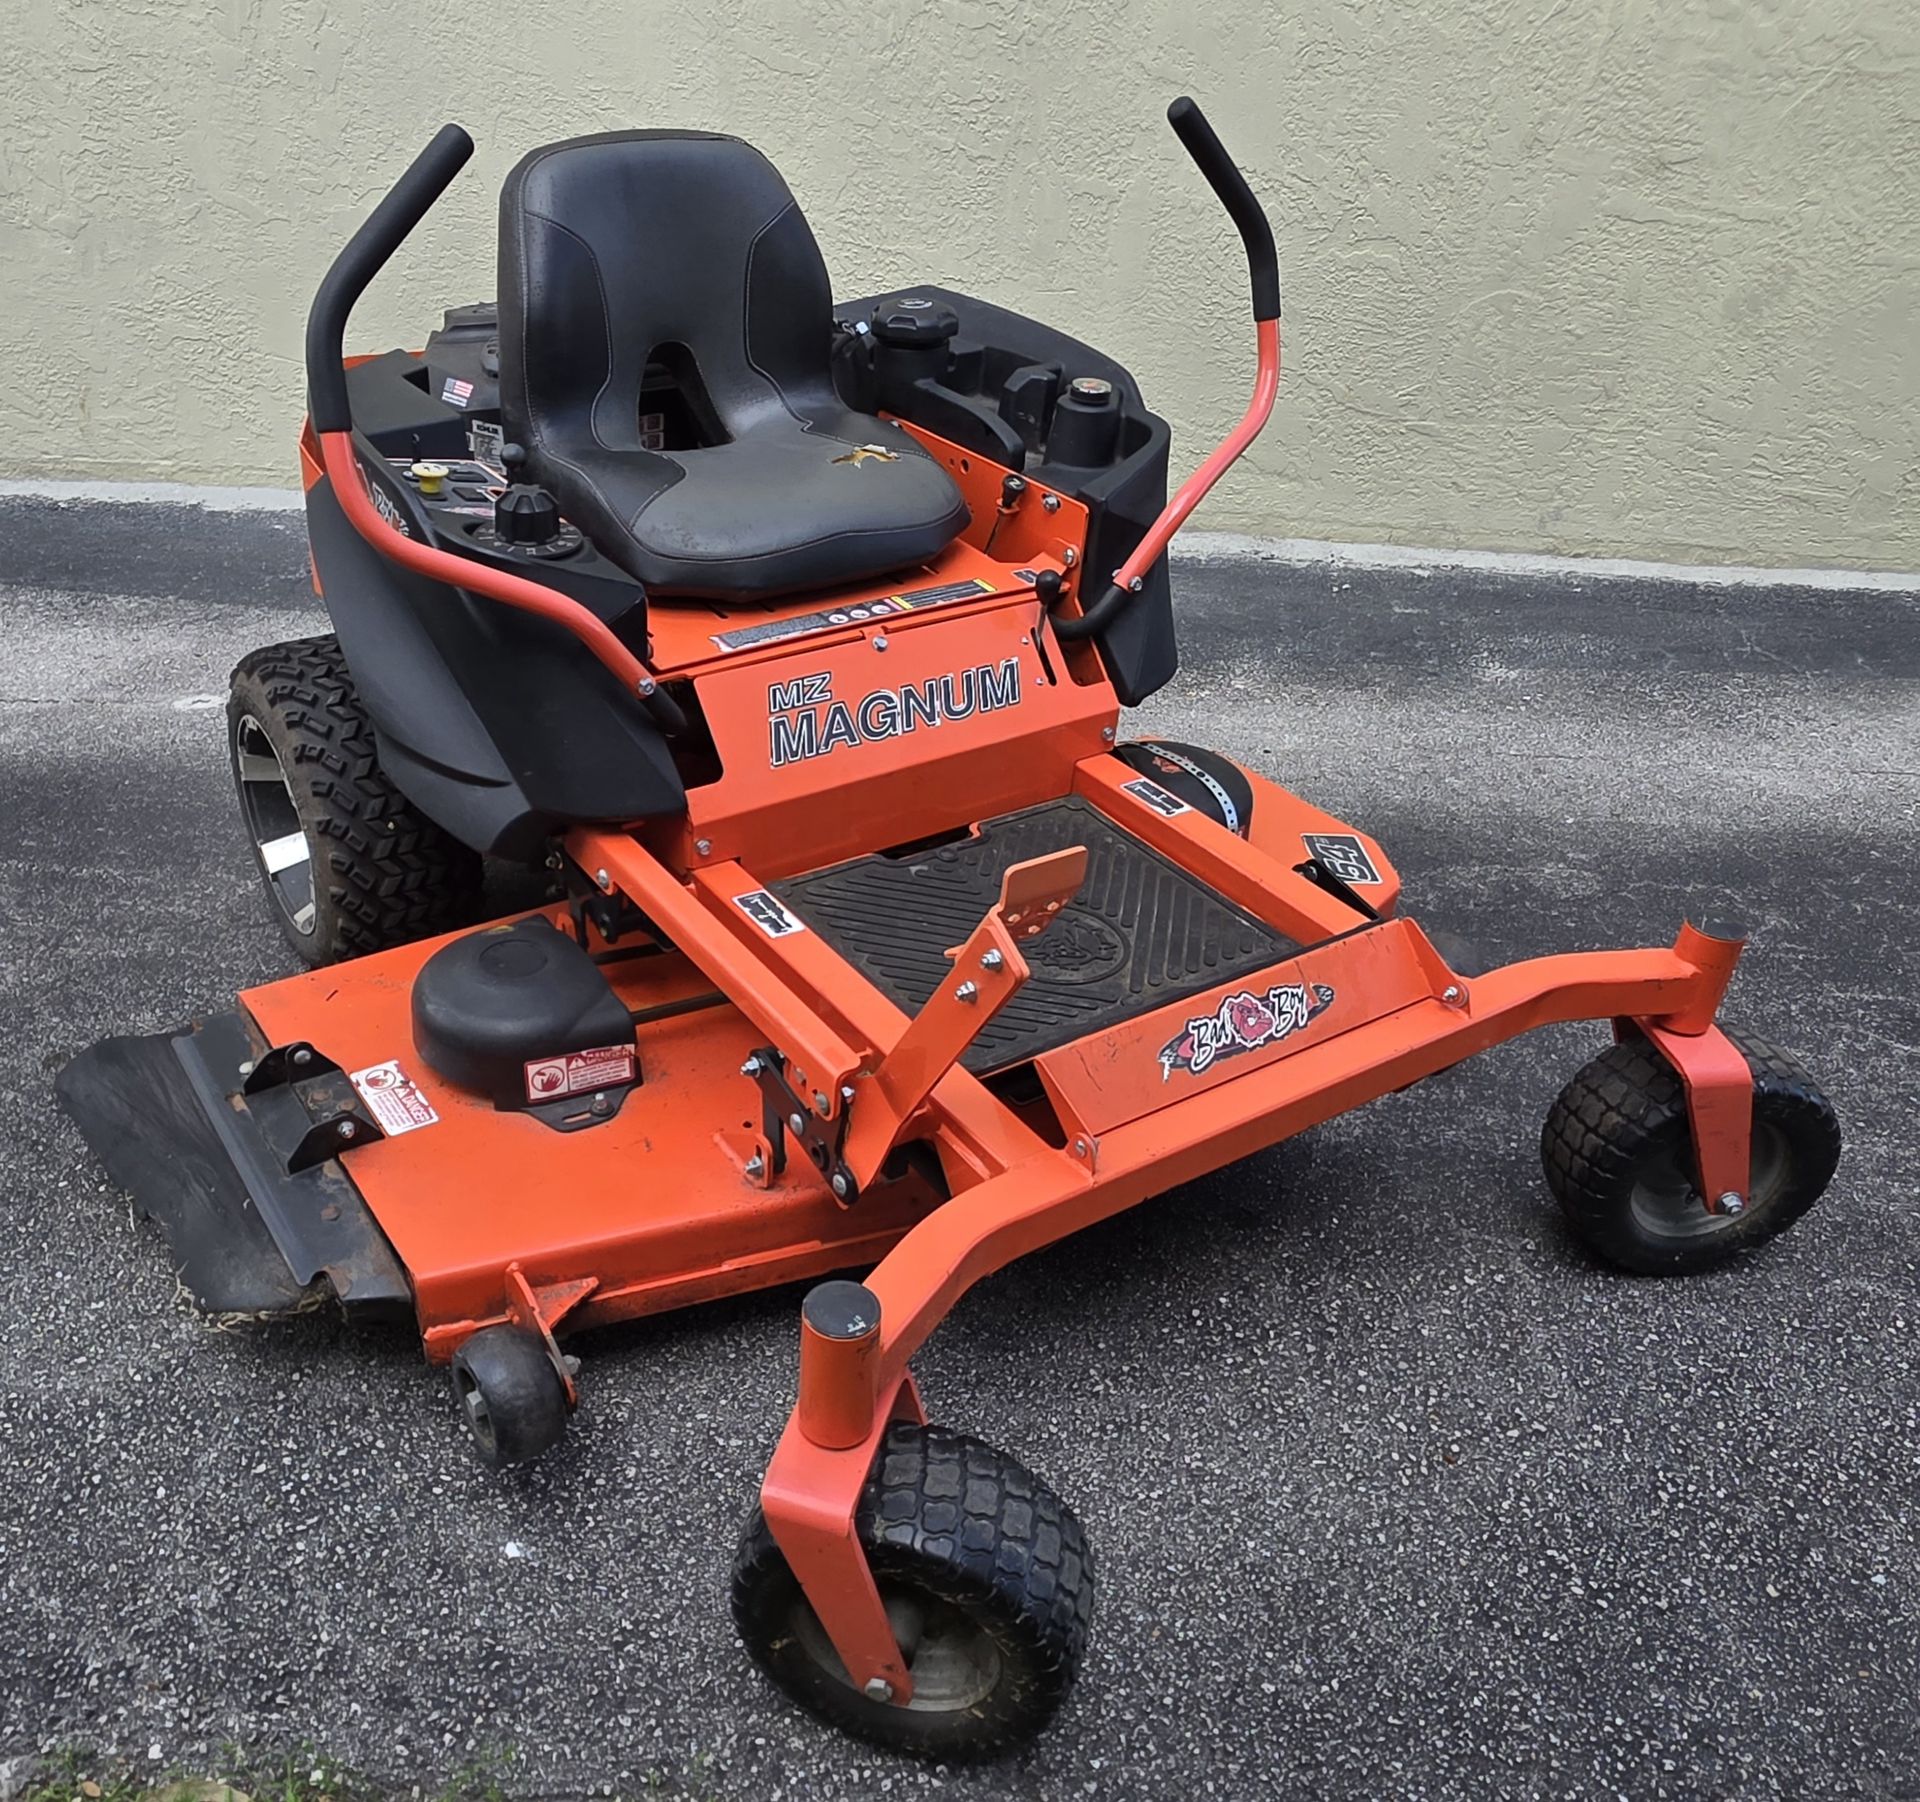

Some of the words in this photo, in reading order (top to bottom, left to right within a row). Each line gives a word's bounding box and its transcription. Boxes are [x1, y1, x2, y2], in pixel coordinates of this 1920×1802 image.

[769, 671, 832, 712] MZ
[769, 658, 1020, 767] MAGNUM
[1315, 842, 1371, 881] 54
